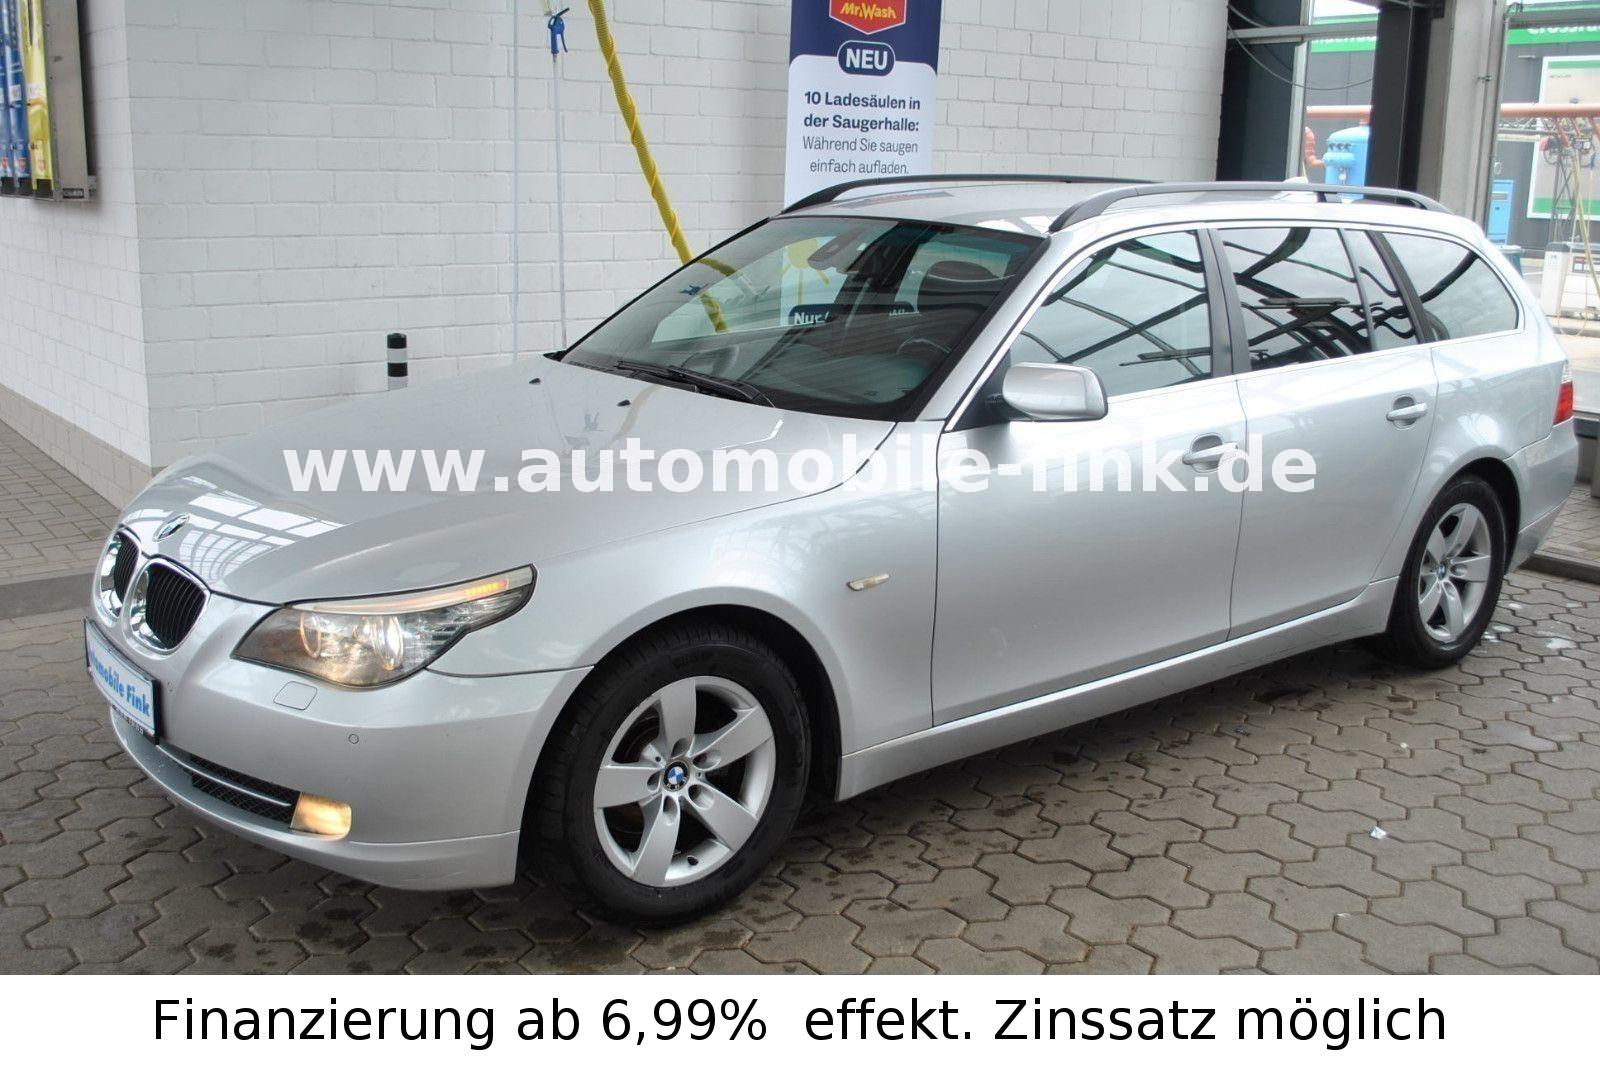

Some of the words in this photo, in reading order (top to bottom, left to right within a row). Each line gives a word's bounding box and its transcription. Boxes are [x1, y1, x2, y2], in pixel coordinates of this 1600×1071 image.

[846, 49, 888, 70] NEU
[804, 91, 821, 105] 10
[825, 91, 905, 110] Ladesäulen
[909, 98, 921, 110] in
[803, 114, 829, 128] der
[832, 115, 919, 132] Saugerhalle:
[802, 136, 857, 152] Während
[860, 137, 877, 152] Sie
[879, 141, 918, 156] saugen
[809, 159, 856, 173] einfach
[858, 160, 909, 174] aufladen.
[126, 682, 150, 717] Fink
